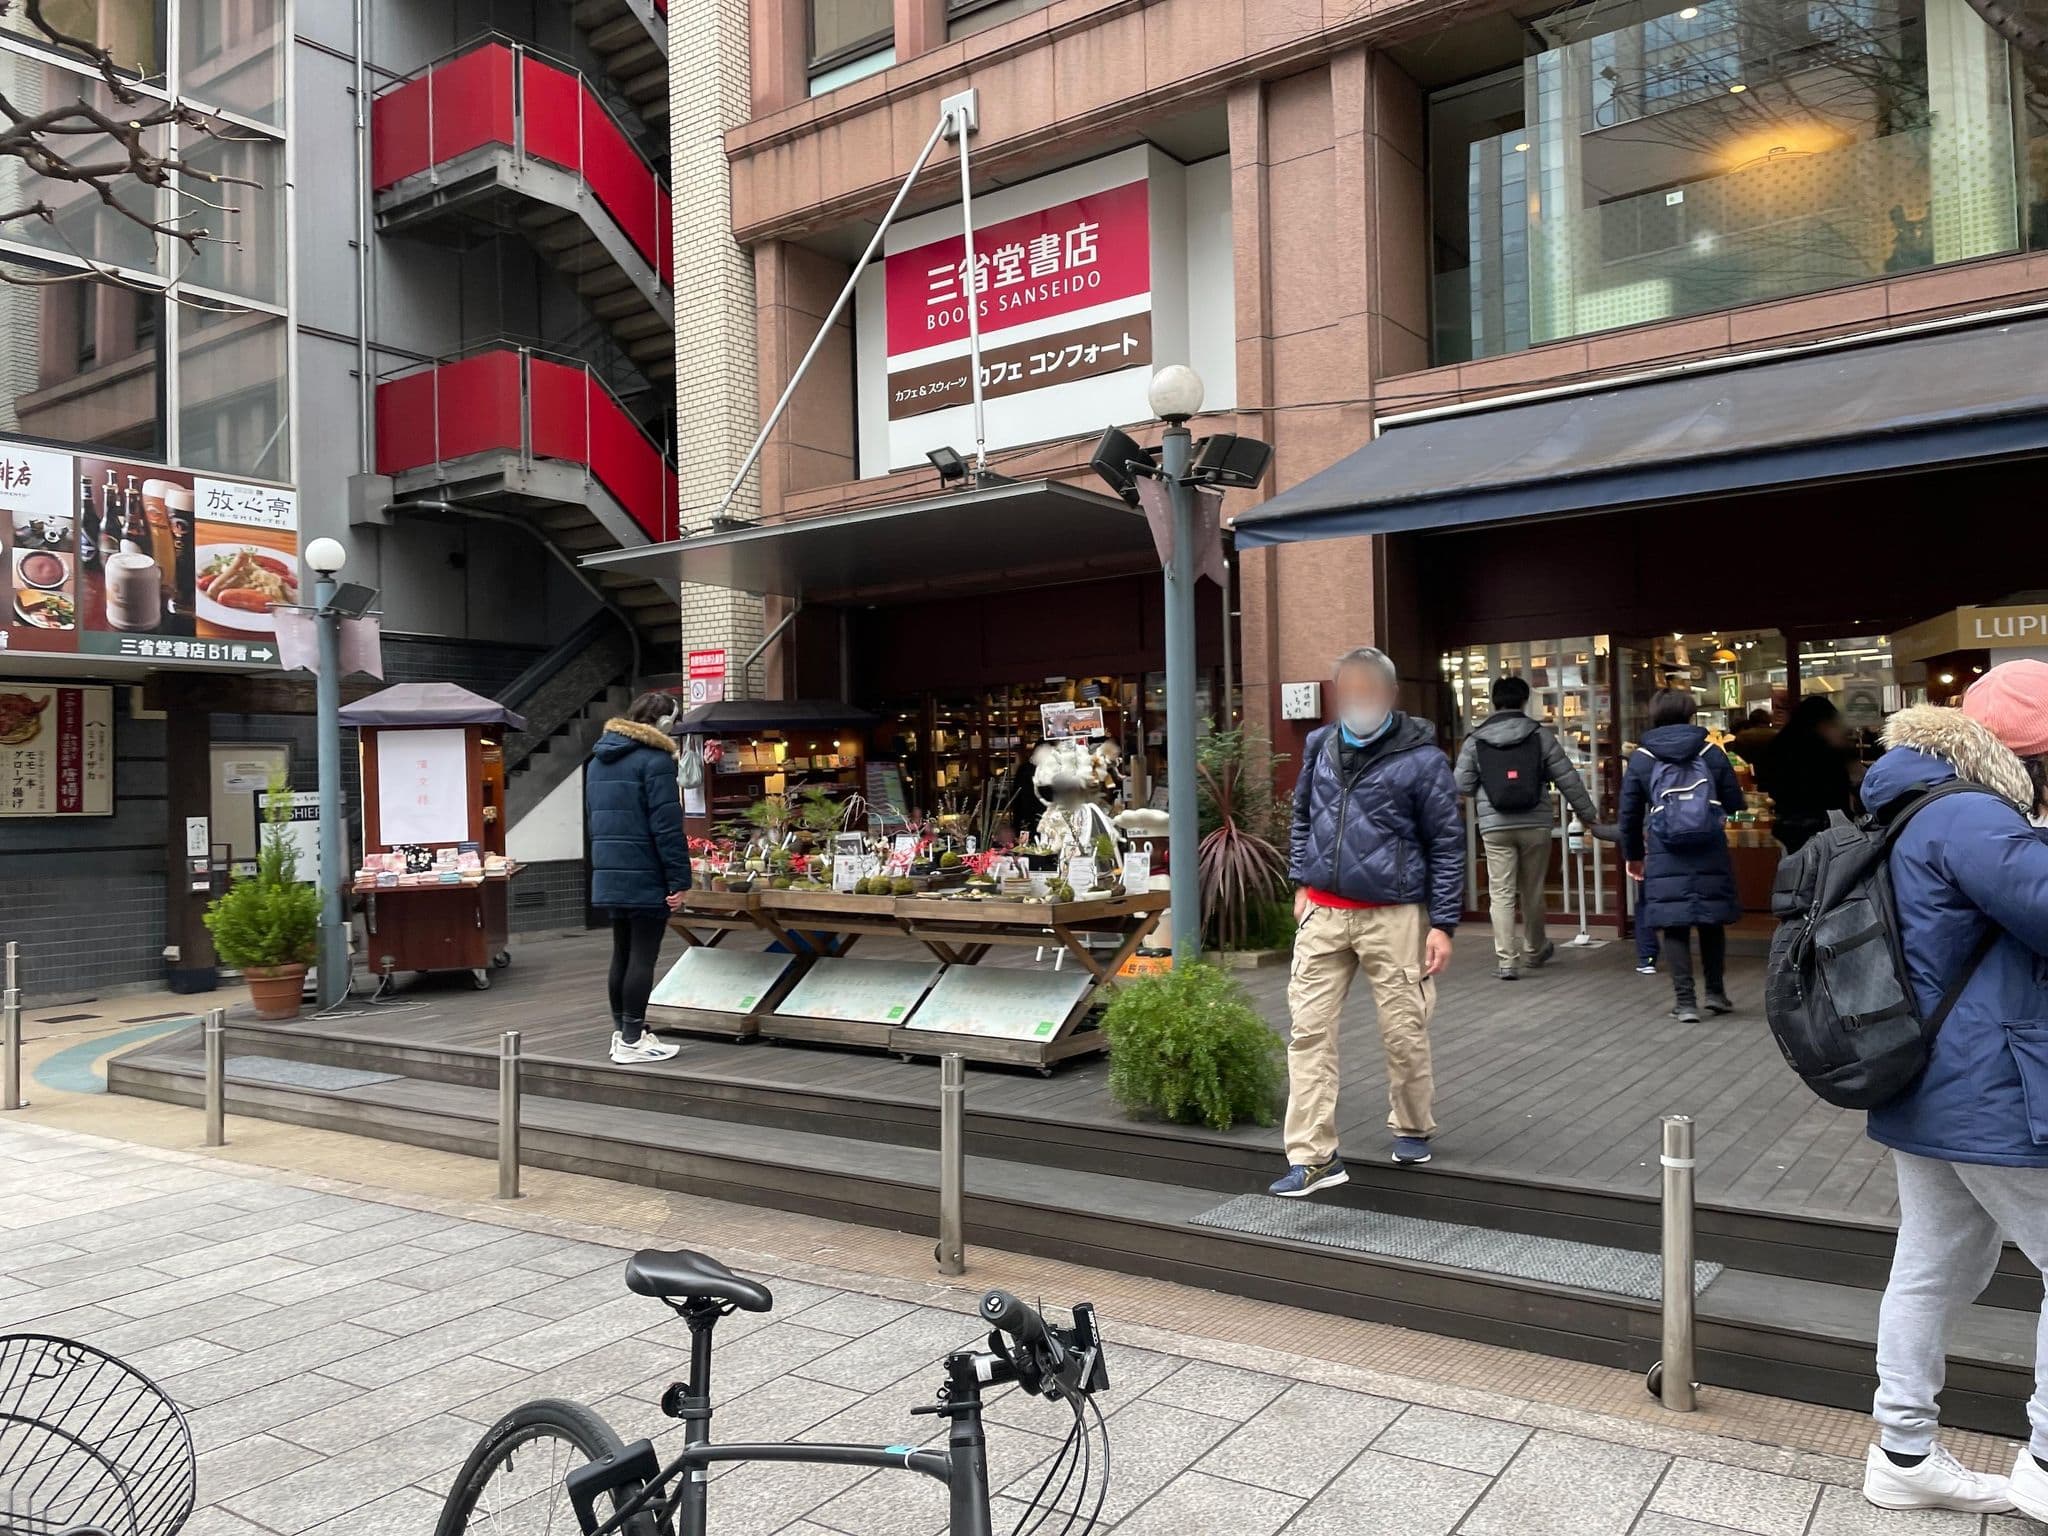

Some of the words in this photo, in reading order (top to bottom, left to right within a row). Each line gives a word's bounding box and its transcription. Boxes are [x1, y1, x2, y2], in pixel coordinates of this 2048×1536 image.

[927, 223, 1099, 305] 三省堂書店
[998, 270, 1102, 311] SANSEIDO
[1029, 332, 1139, 376] コンフォート
[207, 489, 291, 518] 放心亭
[1975, 614, 2047, 639] LUPI
